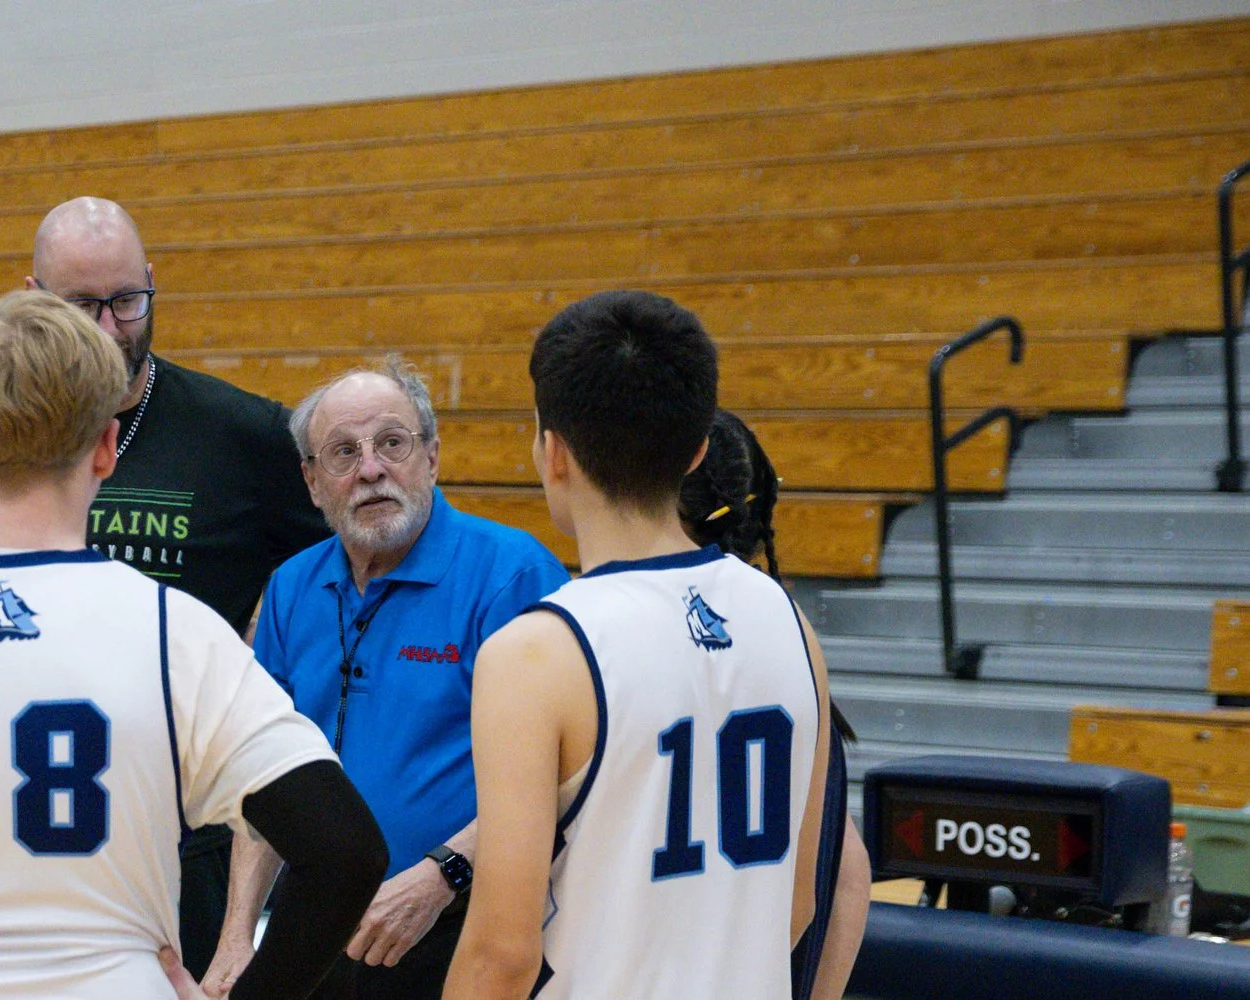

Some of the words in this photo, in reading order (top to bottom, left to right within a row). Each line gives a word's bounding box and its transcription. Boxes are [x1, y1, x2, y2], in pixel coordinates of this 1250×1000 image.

[90, 508, 190, 539] TAINS
[92, 544, 184, 566] YBALL
[651, 704, 794, 882] 10
[935, 818, 1041, 862] POSS.
